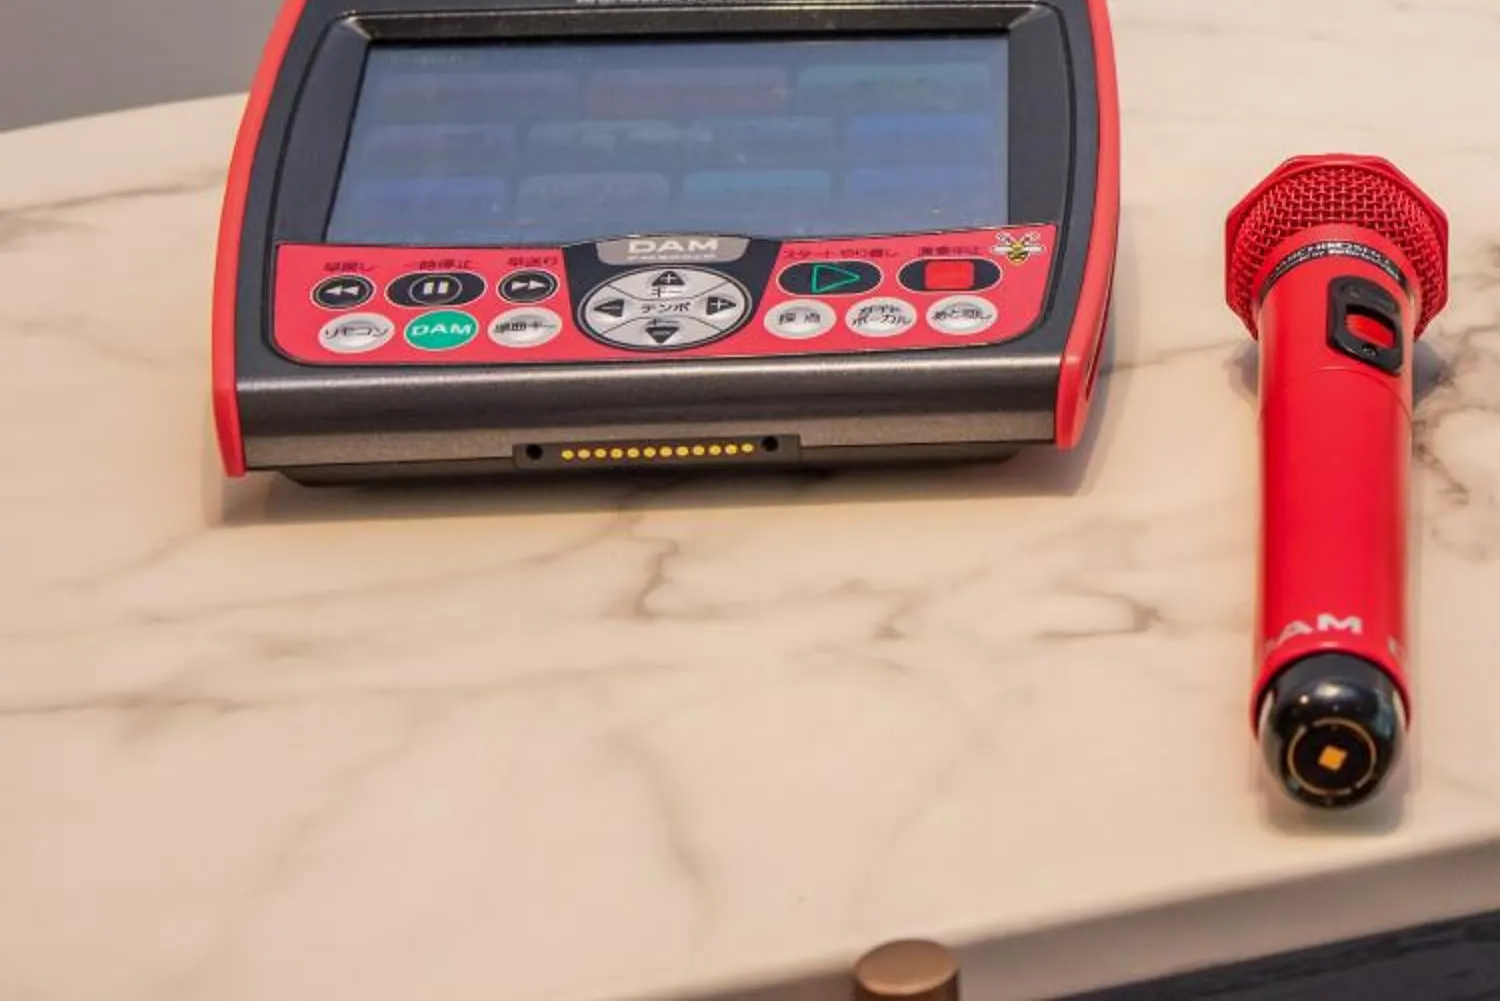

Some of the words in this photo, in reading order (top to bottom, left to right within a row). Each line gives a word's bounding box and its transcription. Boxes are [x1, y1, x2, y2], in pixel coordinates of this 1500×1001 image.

[628, 238, 719, 254] DAM
[641, 301, 692, 314] テンポ
[411, 324, 472, 337] DAM
[1266, 613, 1362, 649] AM
